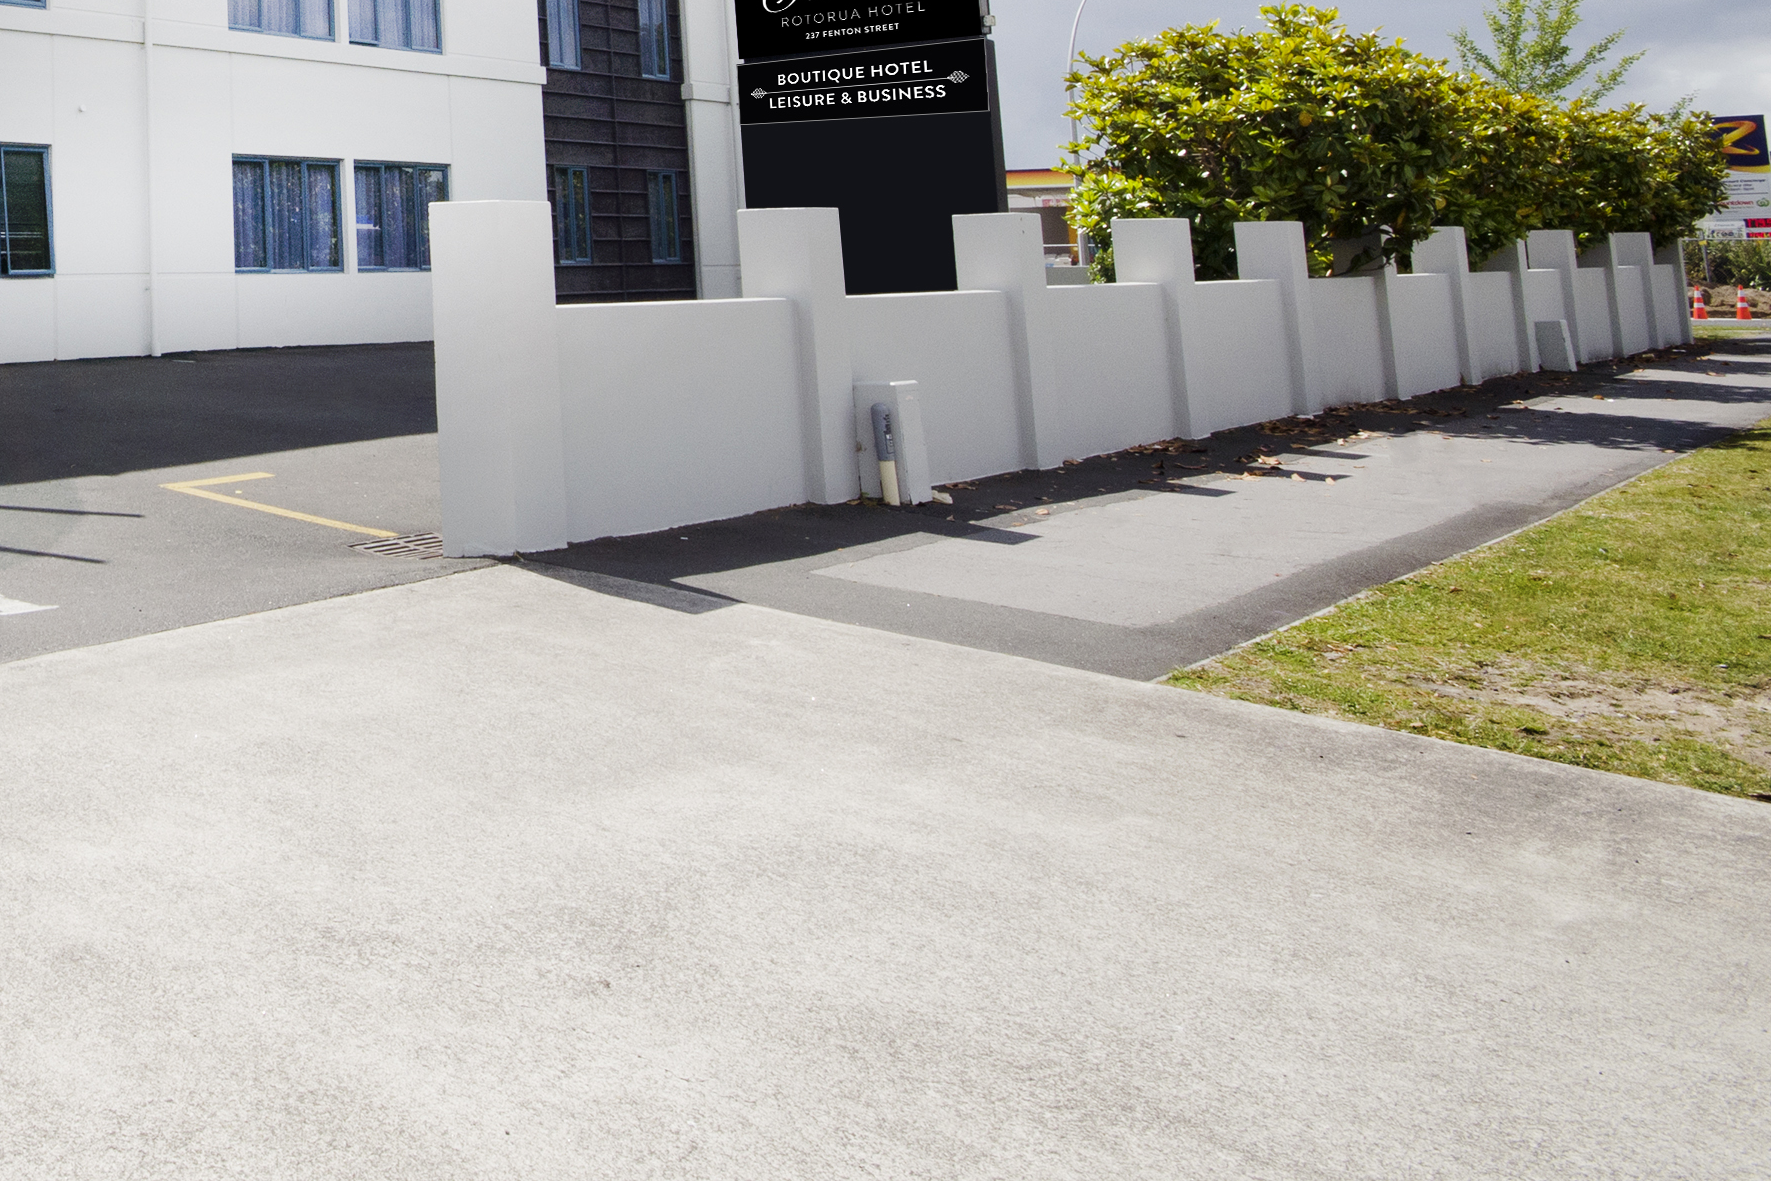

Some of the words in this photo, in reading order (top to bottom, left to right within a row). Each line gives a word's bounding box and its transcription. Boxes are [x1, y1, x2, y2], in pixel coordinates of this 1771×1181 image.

[781, 8, 861, 28] ROTORUA
[868, 1, 926, 18] HOTEL
[805, 31, 820, 40] 237
[822, 27, 862, 38] FENTON
[864, 22, 900, 34] STREET
[777, 66, 865, 86] BOUTIQUE
[871, 60, 933, 78] HOTEL
[769, 92, 836, 109] LEISURE
[840, 92, 853, 104] &
[857, 84, 947, 103] BUSINESS
